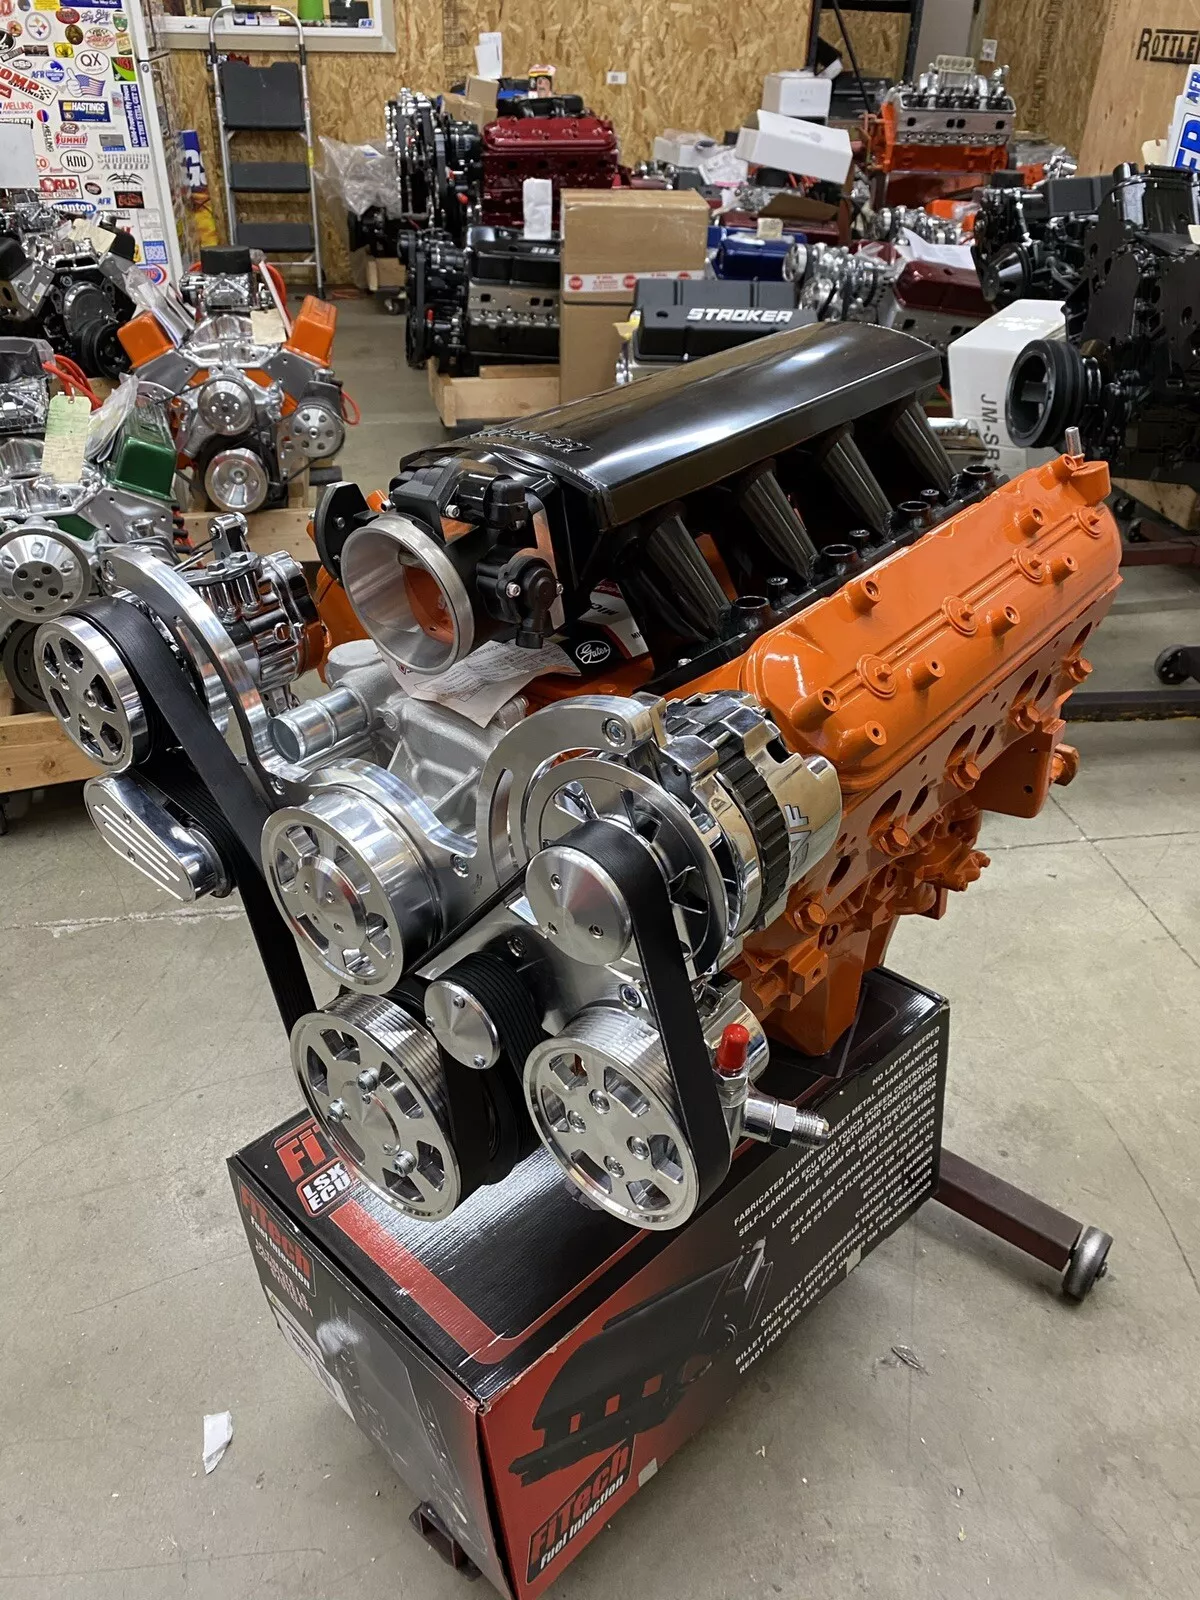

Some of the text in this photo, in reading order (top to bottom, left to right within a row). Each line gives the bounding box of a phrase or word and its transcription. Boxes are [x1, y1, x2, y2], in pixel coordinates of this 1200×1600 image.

[0, 67, 40, 91] OMP
[80, 53, 102, 67] QX
[72, 102, 105, 112] HASTINGS
[687, 307, 793, 323] STROKER
[872, 1025, 940, 1086] NO LAPTOP NEEDED
[734, 1039, 939, 1227] FABRICATED ALUMIN SHEET METAL INTAKE MANIFOLD
[738, 1052, 938, 1237] SELF-LEARNING ECU WITH TOUCH SCREEN CONTROLLER
[771, 1073, 937, 1229] LOW-PROFILE, 92MM OR 102MM THROTTLE BODY
[805, 1060, 938, 1183] FOR EASY SETUP AND CONFIGURATION
[859, 1132, 878, 1152] WITH
[879, 1119, 892, 1134] TPS
[900, 1101, 912, 1116] IAC
[912, 1080, 937, 1104] MOTOR
[873, 1164, 884, 1177] HP
[884, 1154, 895, 1167] OR
[908, 1133, 918, 1145] HP
[919, 1118, 935, 1136] KITS
[308, 1171, 353, 1212] ECU
[790, 1214, 805, 1233] 24X
[805, 1198, 821, 1218] AND
[836, 1159, 862, 1186] CRANK
[862, 1145, 878, 1162] AND
[878, 1129, 894, 1147] CAM
[894, 1092, 936, 1132] COMPATIBLE
[801, 1220, 812, 1234] OR
[845, 1139, 898, 1192] FLOW-MATCHED
[898, 1105, 936, 1142] INJECTORS
[855, 1143, 933, 1218] CUSTOM WIRE HARNESS
[862, 1173, 887, 1199] BOSCH
[888, 1157, 905, 1176] WIDE
[905, 1140, 924, 1160] BAND
[250, 1214, 269, 1242] Fuel
[269, 1238, 310, 1290] Injection
[735, 1334, 762, 1365] BILLET
[763, 1315, 783, 1337] FUEL
[784, 1291, 804, 1316] RAILS
[806, 1270, 824, 1292] WITH
[824, 1259, 835, 1273] AN
[835, 1227, 867, 1261] FITTINGS
[875, 1205, 893, 1223] FUEL
[894, 1168, 932, 1207] CROSSOVER
[760, 1280, 803, 1327] ON-THE-FLY
[803, 1222, 860, 1283] PROGRAMMABLE
[861, 1196, 888, 1224] TARGET
[889, 1184, 903, 1200] AFR
[910, 1155, 933, 1180] TIMING
[739, 1344, 765, 1374] READY
[766, 1328, 782, 1347] FOR
[540, 1475, 624, 1570] Fuel Injection
